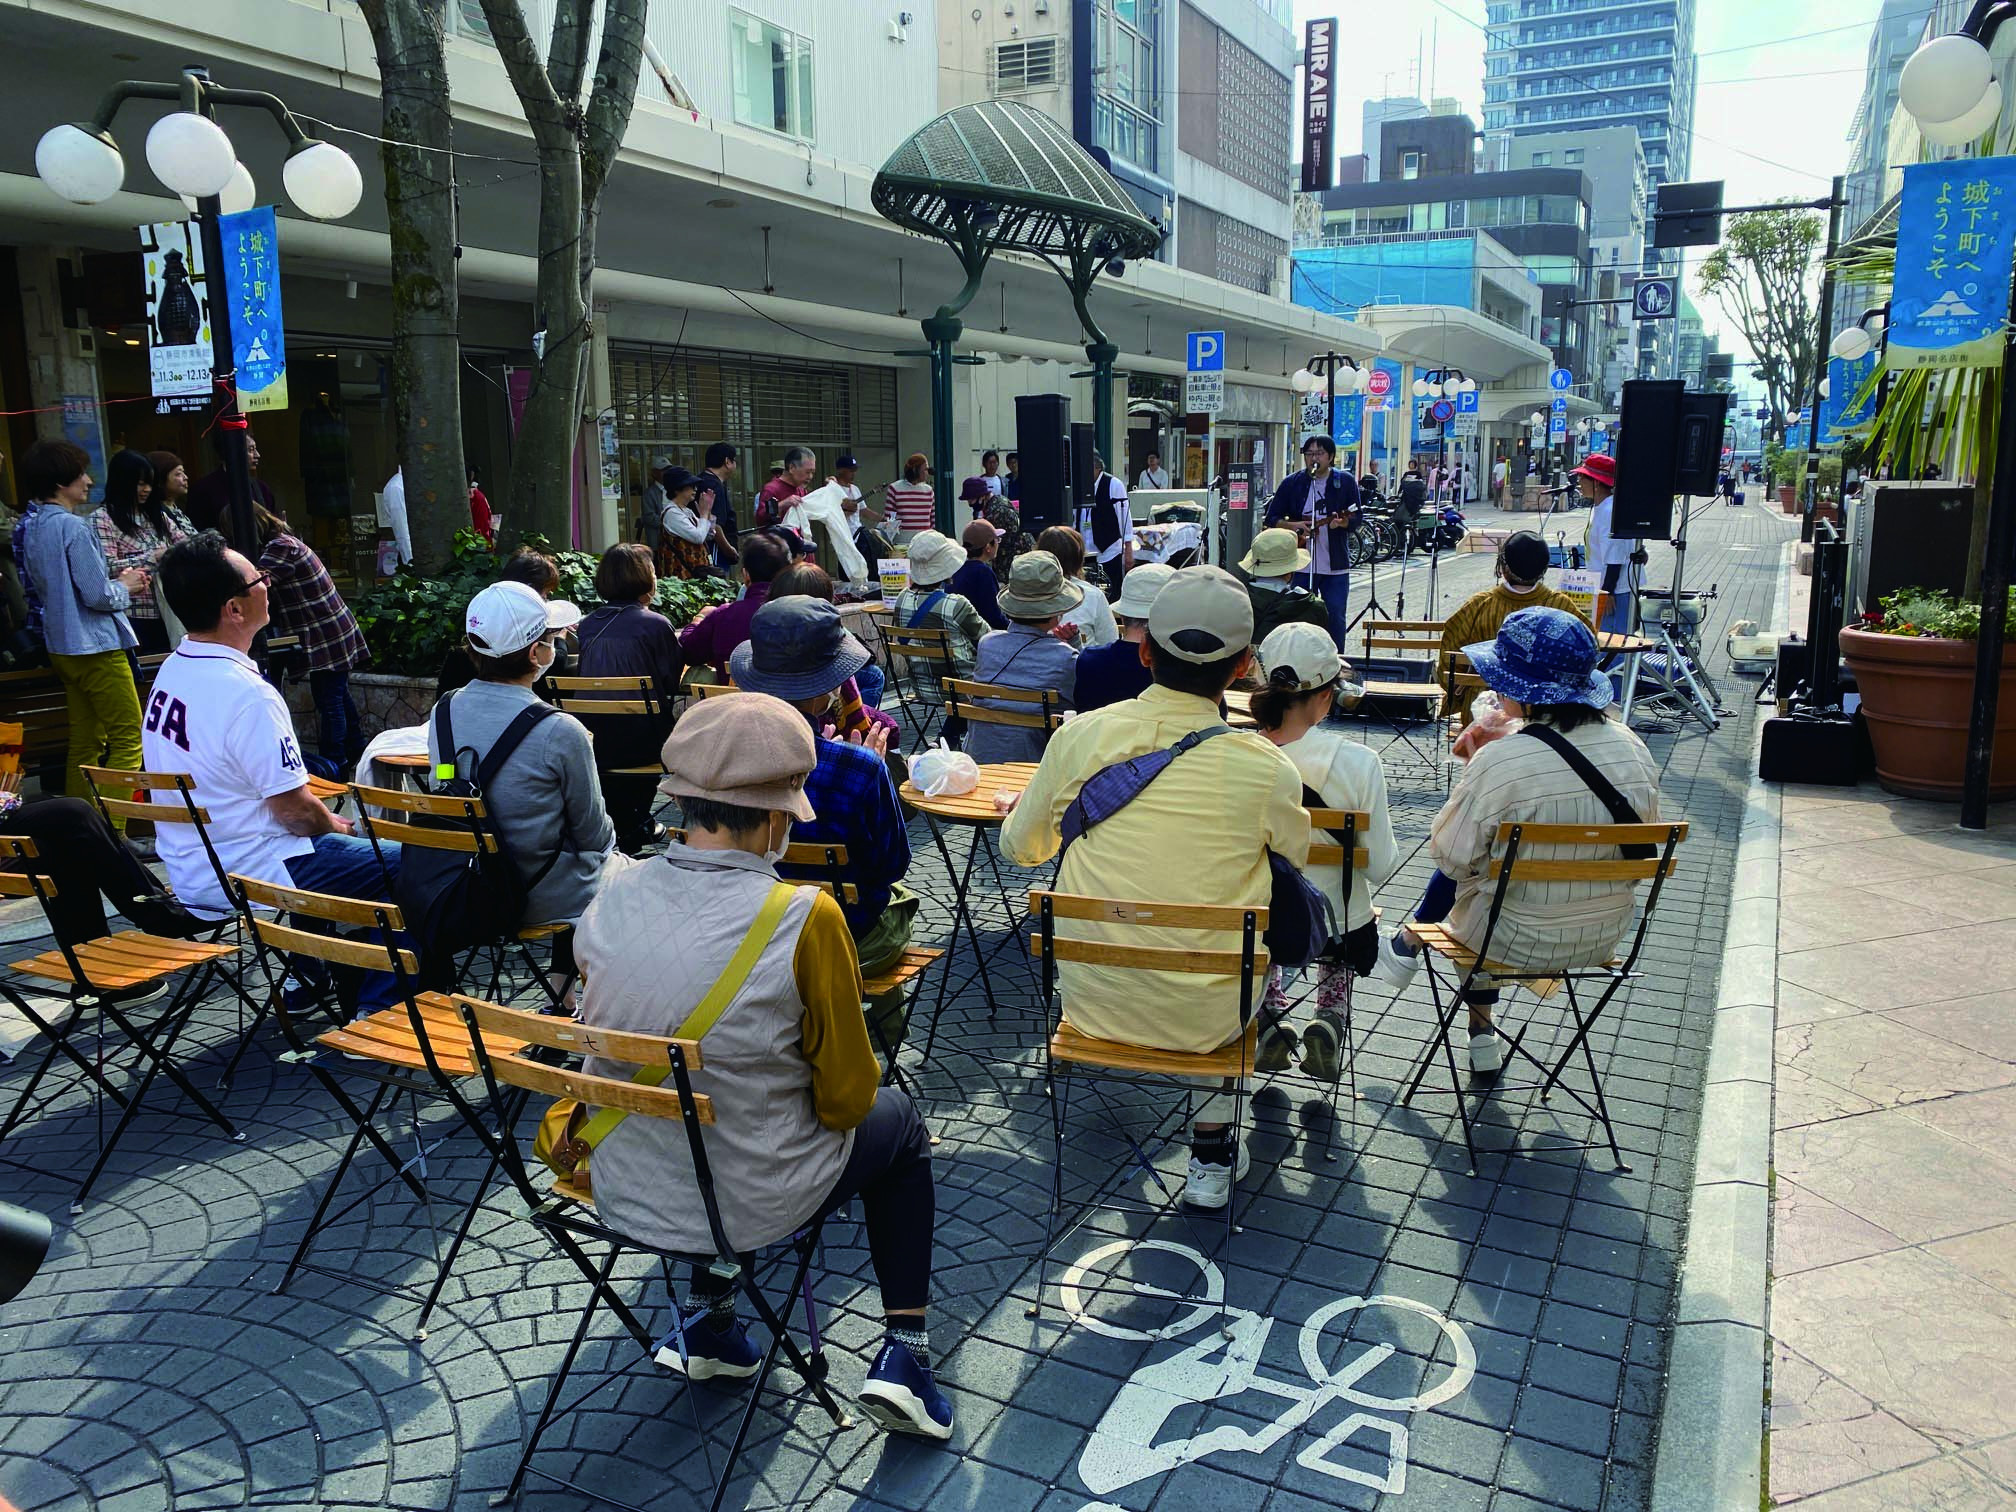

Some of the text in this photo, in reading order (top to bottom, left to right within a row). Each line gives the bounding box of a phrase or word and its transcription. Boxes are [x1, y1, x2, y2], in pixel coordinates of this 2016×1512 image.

[1310, 22, 1330, 119] MIRAIE
[1926, 182, 1953, 279] ようこそ
[1955, 180, 1991, 272] 城下町へ
[238, 232, 254, 327] ようこそ
[249, 229, 269, 319] 城下町へ
[1197, 336, 1218, 369] P
[1462, 393, 1475, 411] P
[1555, 420, 1564, 431] P
[145, 688, 190, 752] SA
[279, 736, 302, 771] 45
